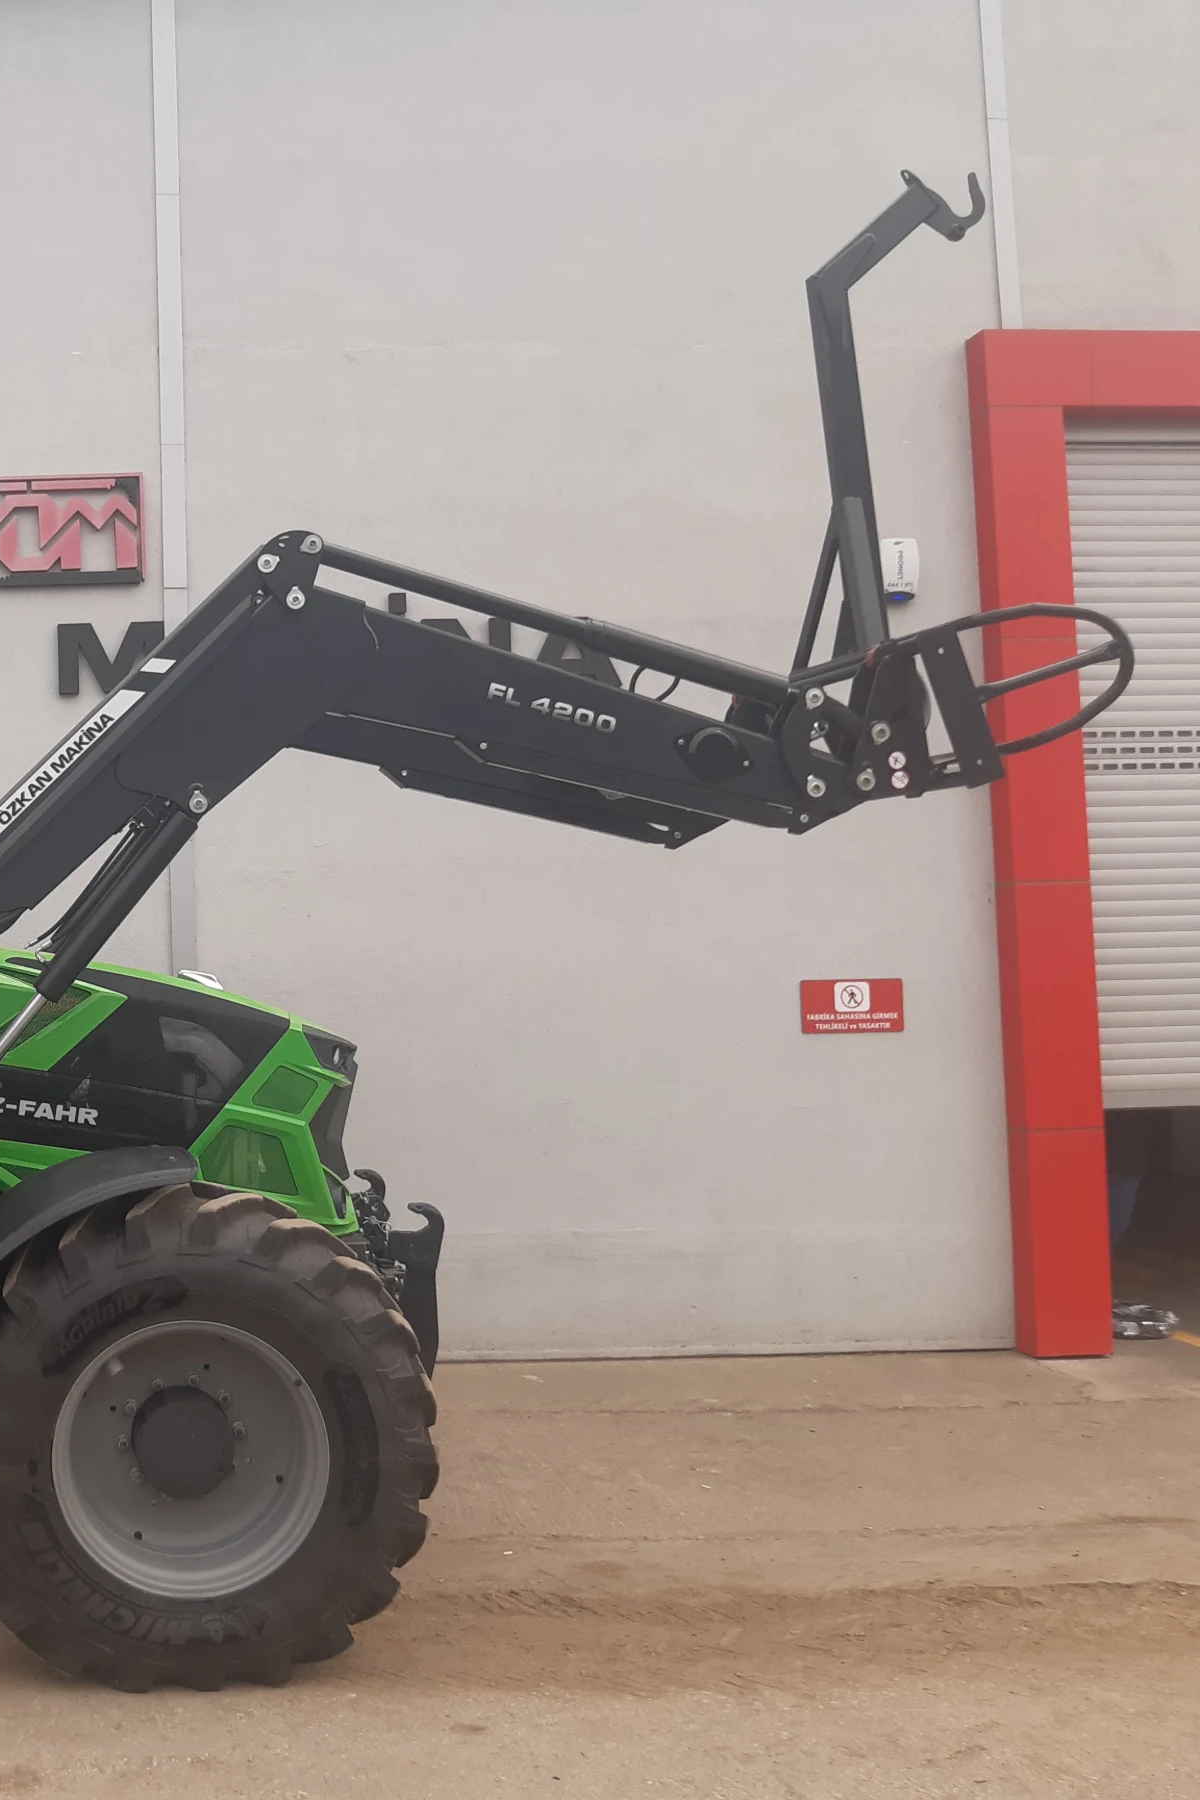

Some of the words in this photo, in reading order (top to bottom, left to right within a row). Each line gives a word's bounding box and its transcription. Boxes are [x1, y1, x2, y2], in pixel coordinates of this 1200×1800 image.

[486, 681, 521, 708] FL
[530, 697, 617, 735] 4200
[49, 713, 115, 774] MAKİNA
[806, 1012, 835, 1021] FABRİKA
[836, 1012, 871, 1020] SAHASINA
[872, 1011, 898, 1020] GİRMEK
[815, 1022, 848, 1030] TEHLİKELİ
[858, 1022, 891, 1030] YASAKTIR
[16, 1519, 196, 1646] MICHELIN
